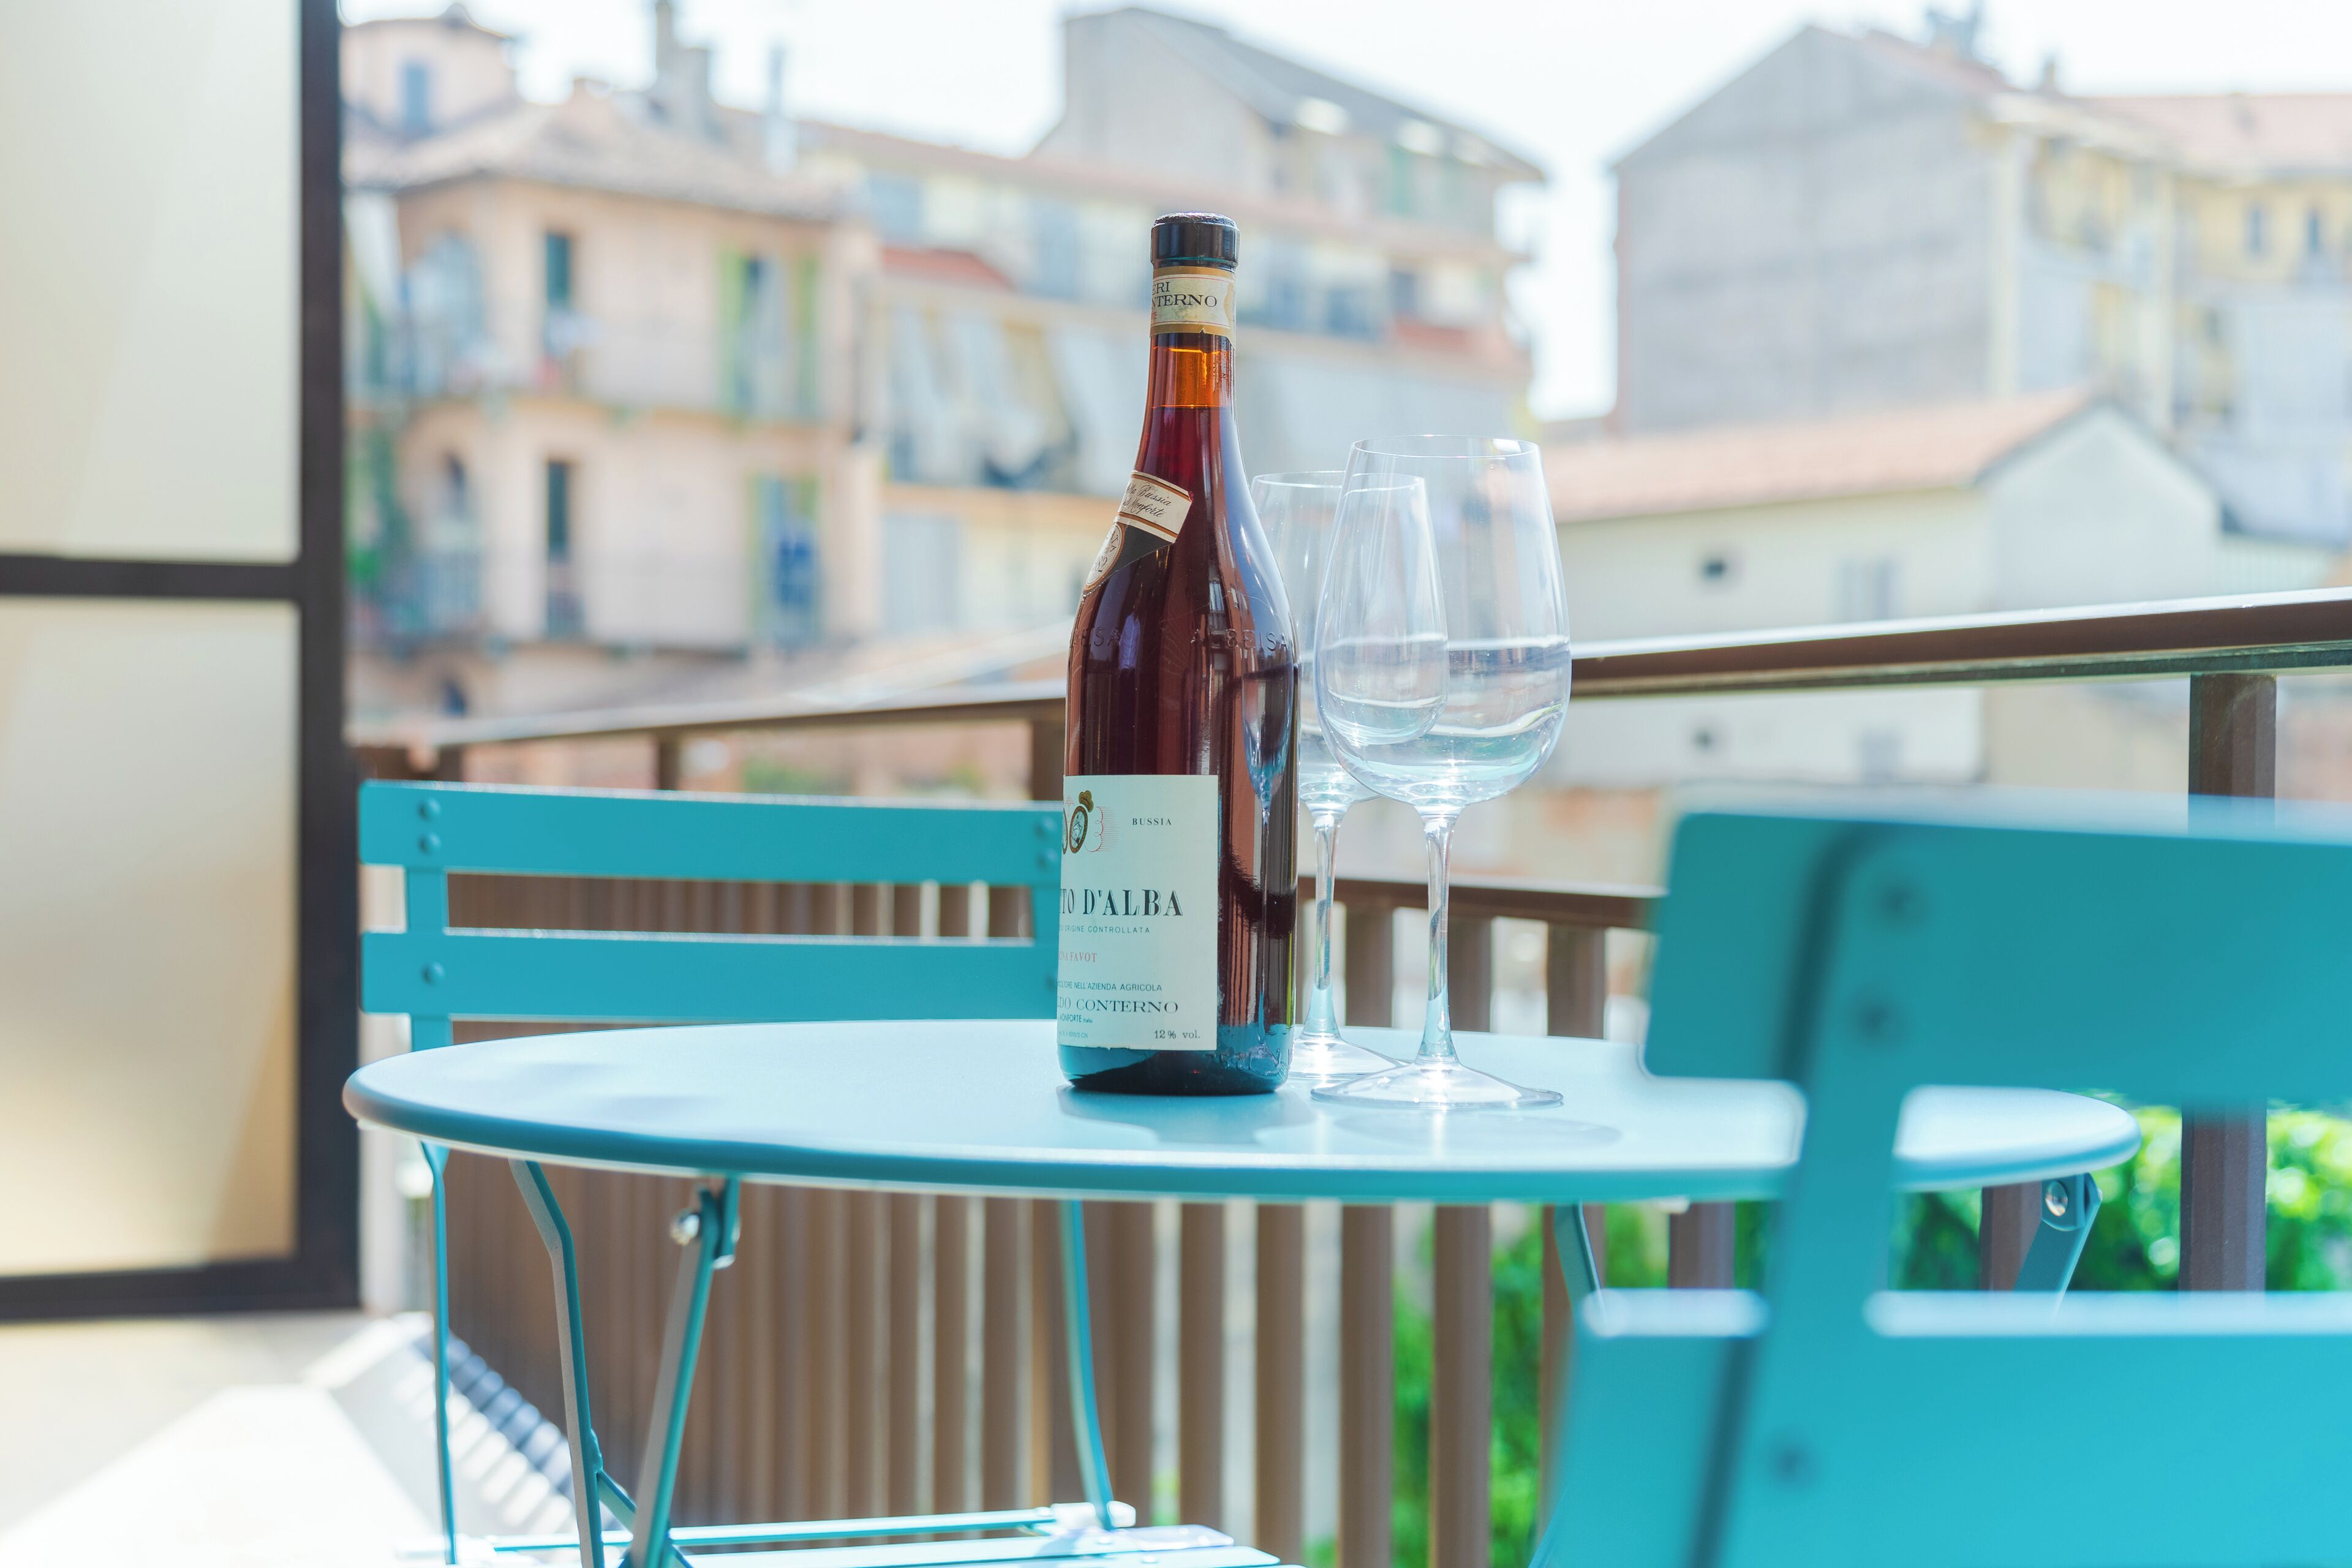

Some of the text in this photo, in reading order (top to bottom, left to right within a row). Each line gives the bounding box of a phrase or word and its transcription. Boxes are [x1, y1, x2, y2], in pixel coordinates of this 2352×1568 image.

[1139, 483, 1171, 507] Bussia
[1131, 498, 1166, 518] Monforte
[1060, 888, 1183, 916] TO D'ALBA
[1070, 952, 1097, 962] FAVOT
[1074, 981, 1117, 990] NELL'AZIENDA
[1120, 983, 1163, 992] AGRICOLA
[1076, 998, 1178, 1014] CONTERNO
[1182, 1030, 1200, 1039] vol.
